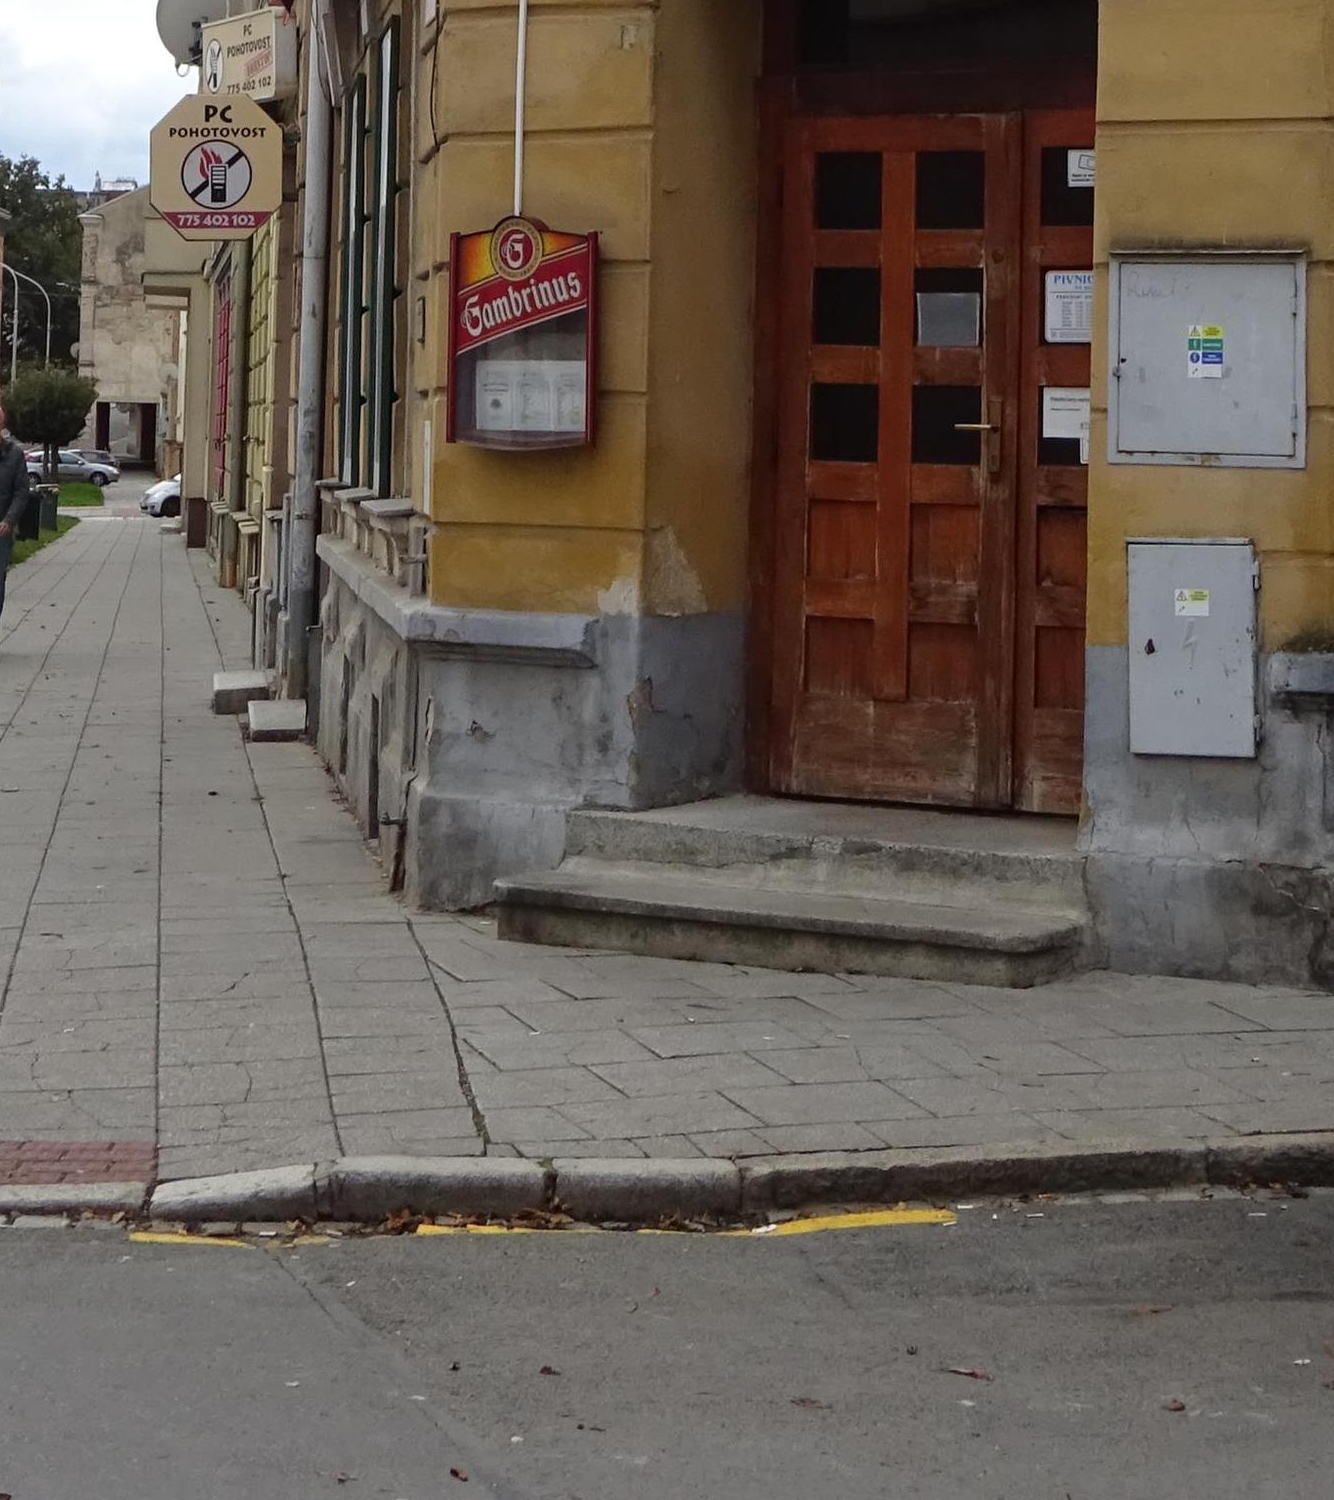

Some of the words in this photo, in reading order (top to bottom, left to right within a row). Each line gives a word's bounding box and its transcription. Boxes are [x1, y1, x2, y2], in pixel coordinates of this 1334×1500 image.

[243, 24, 253, 37] PC
[227, 36, 271, 58] POHOTOVOST
[258, 75, 272, 88] 102
[204, 104, 233, 123] PC
[169, 127, 267, 138] POHOTOVOST
[177, 214, 201, 226] 775
[202, 214, 230, 226] 402
[232, 214, 255, 226] 102
[1054, 274, 1094, 285] PIVNIC
[461, 271, 581, 338] Gambrinus
